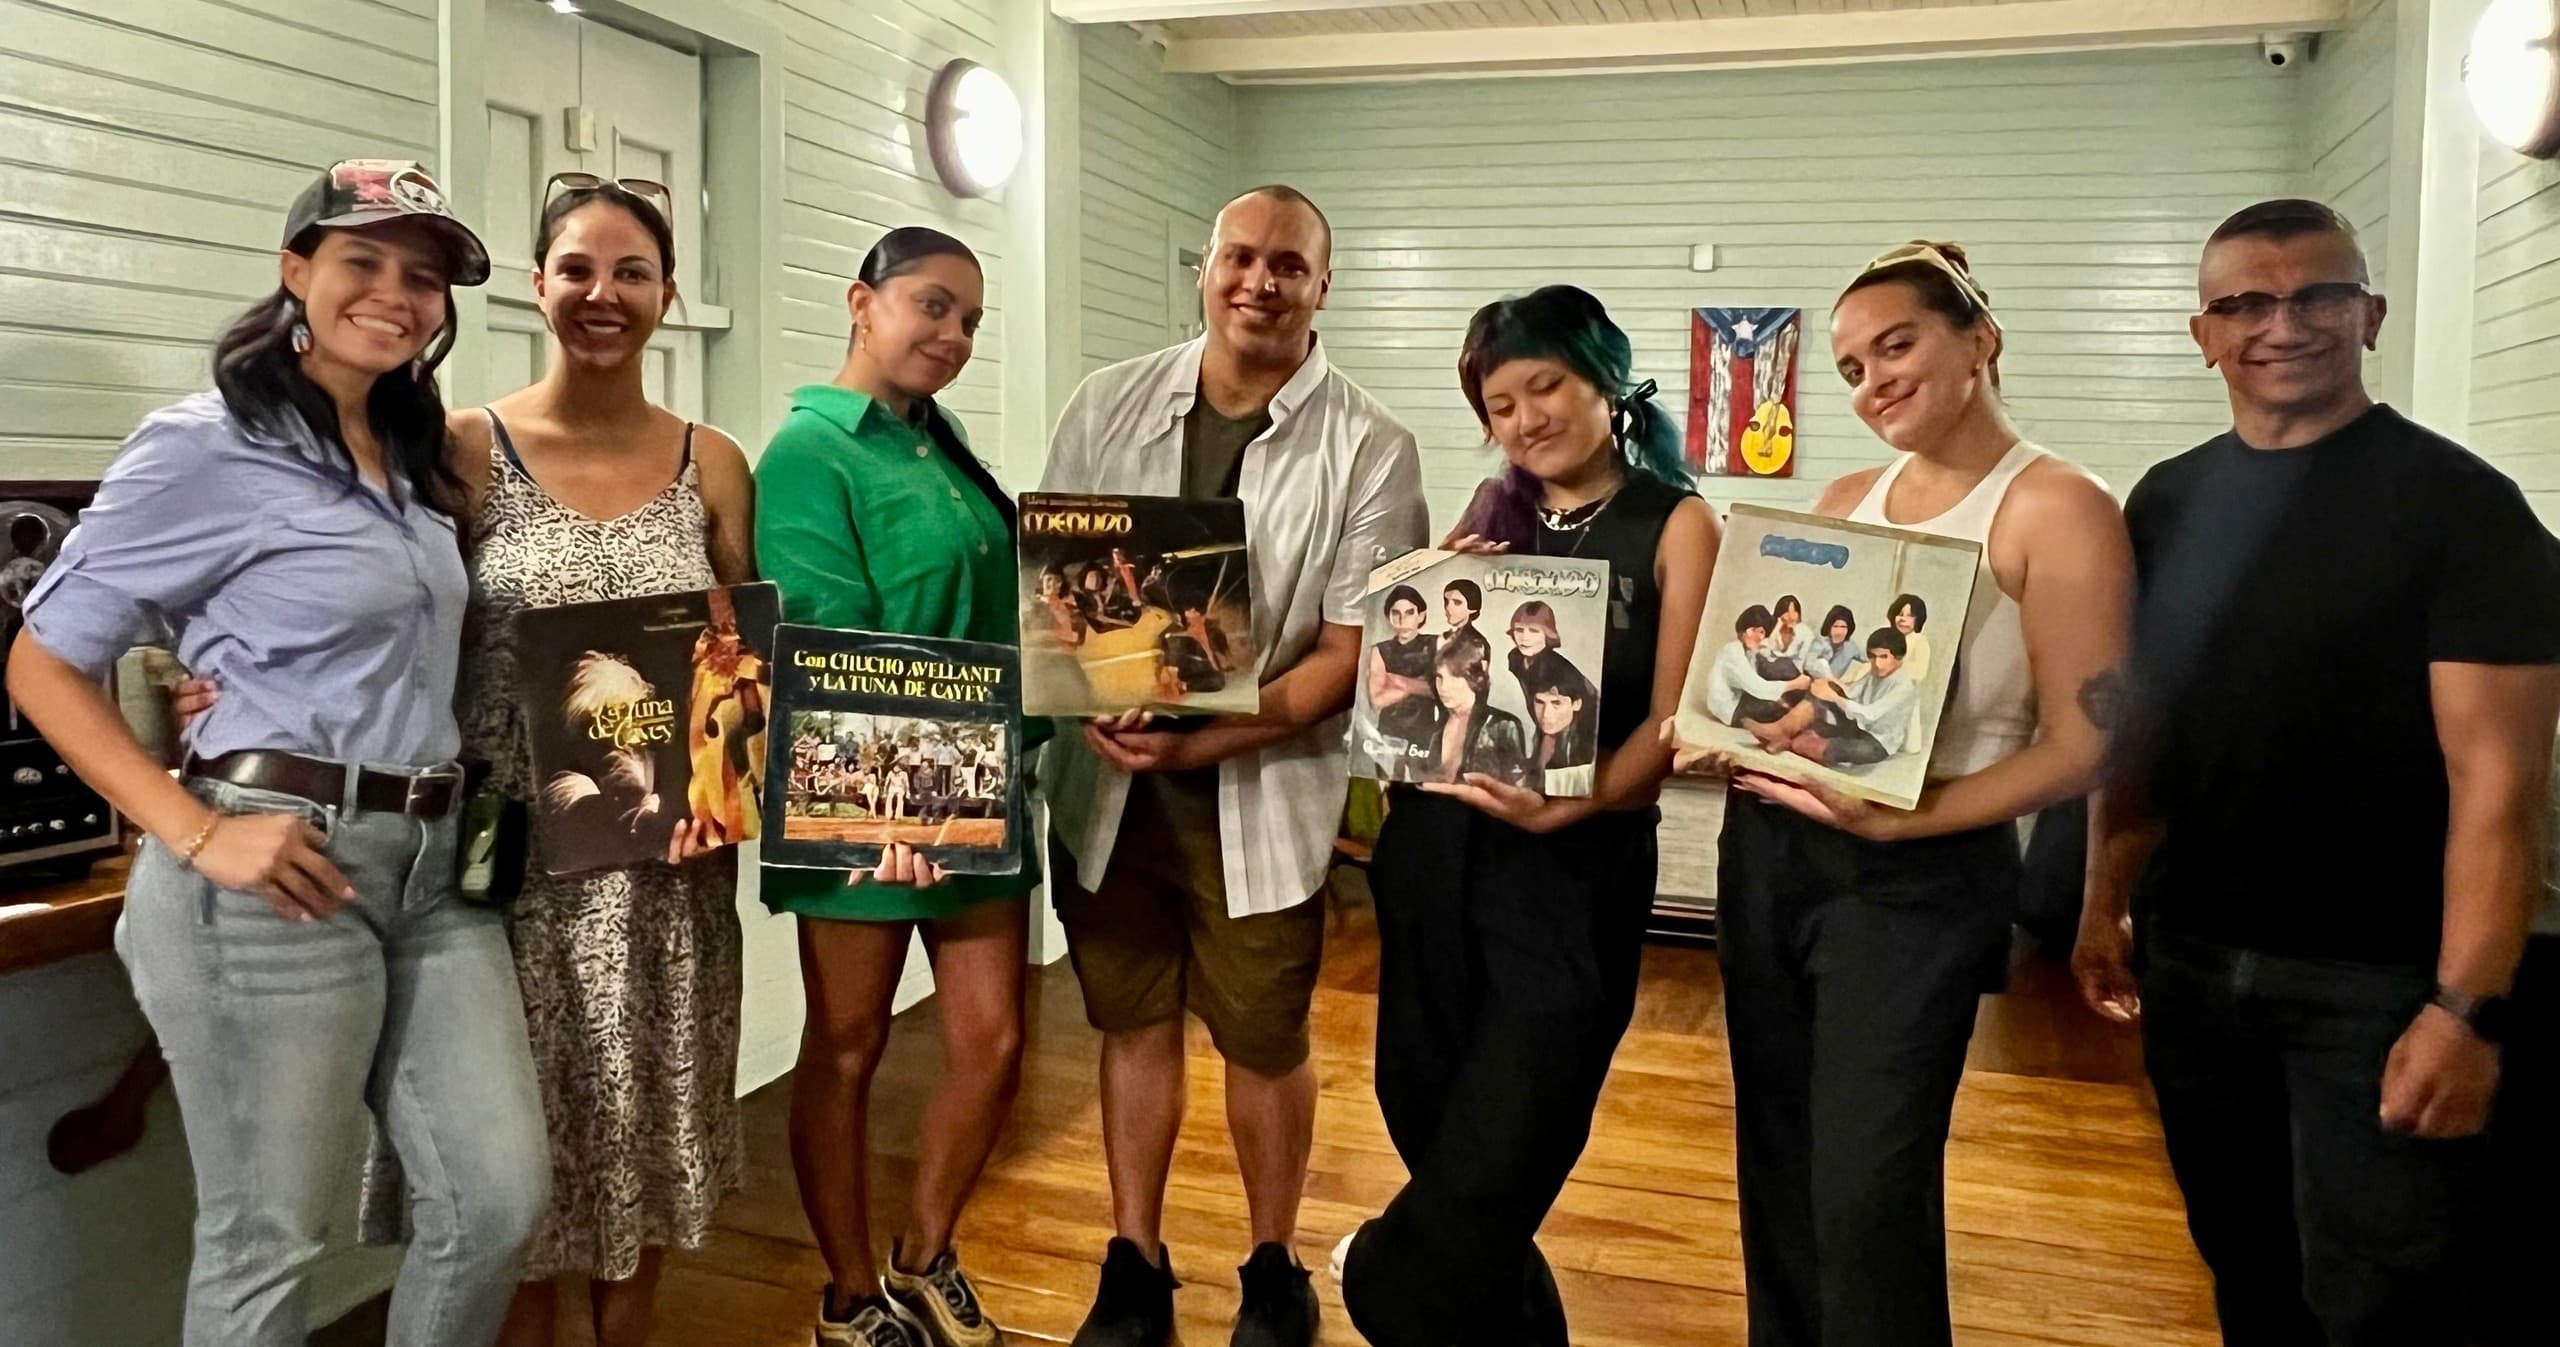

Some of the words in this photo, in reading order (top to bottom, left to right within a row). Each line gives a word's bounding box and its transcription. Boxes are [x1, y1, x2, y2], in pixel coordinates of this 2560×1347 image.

[794, 650, 826, 668] Con
[830, 652, 904, 675] CHUCHO
[809, 675, 821, 692] y
[904, 680, 926, 697] DE
[931, 682, 988, 702] CAYEY
